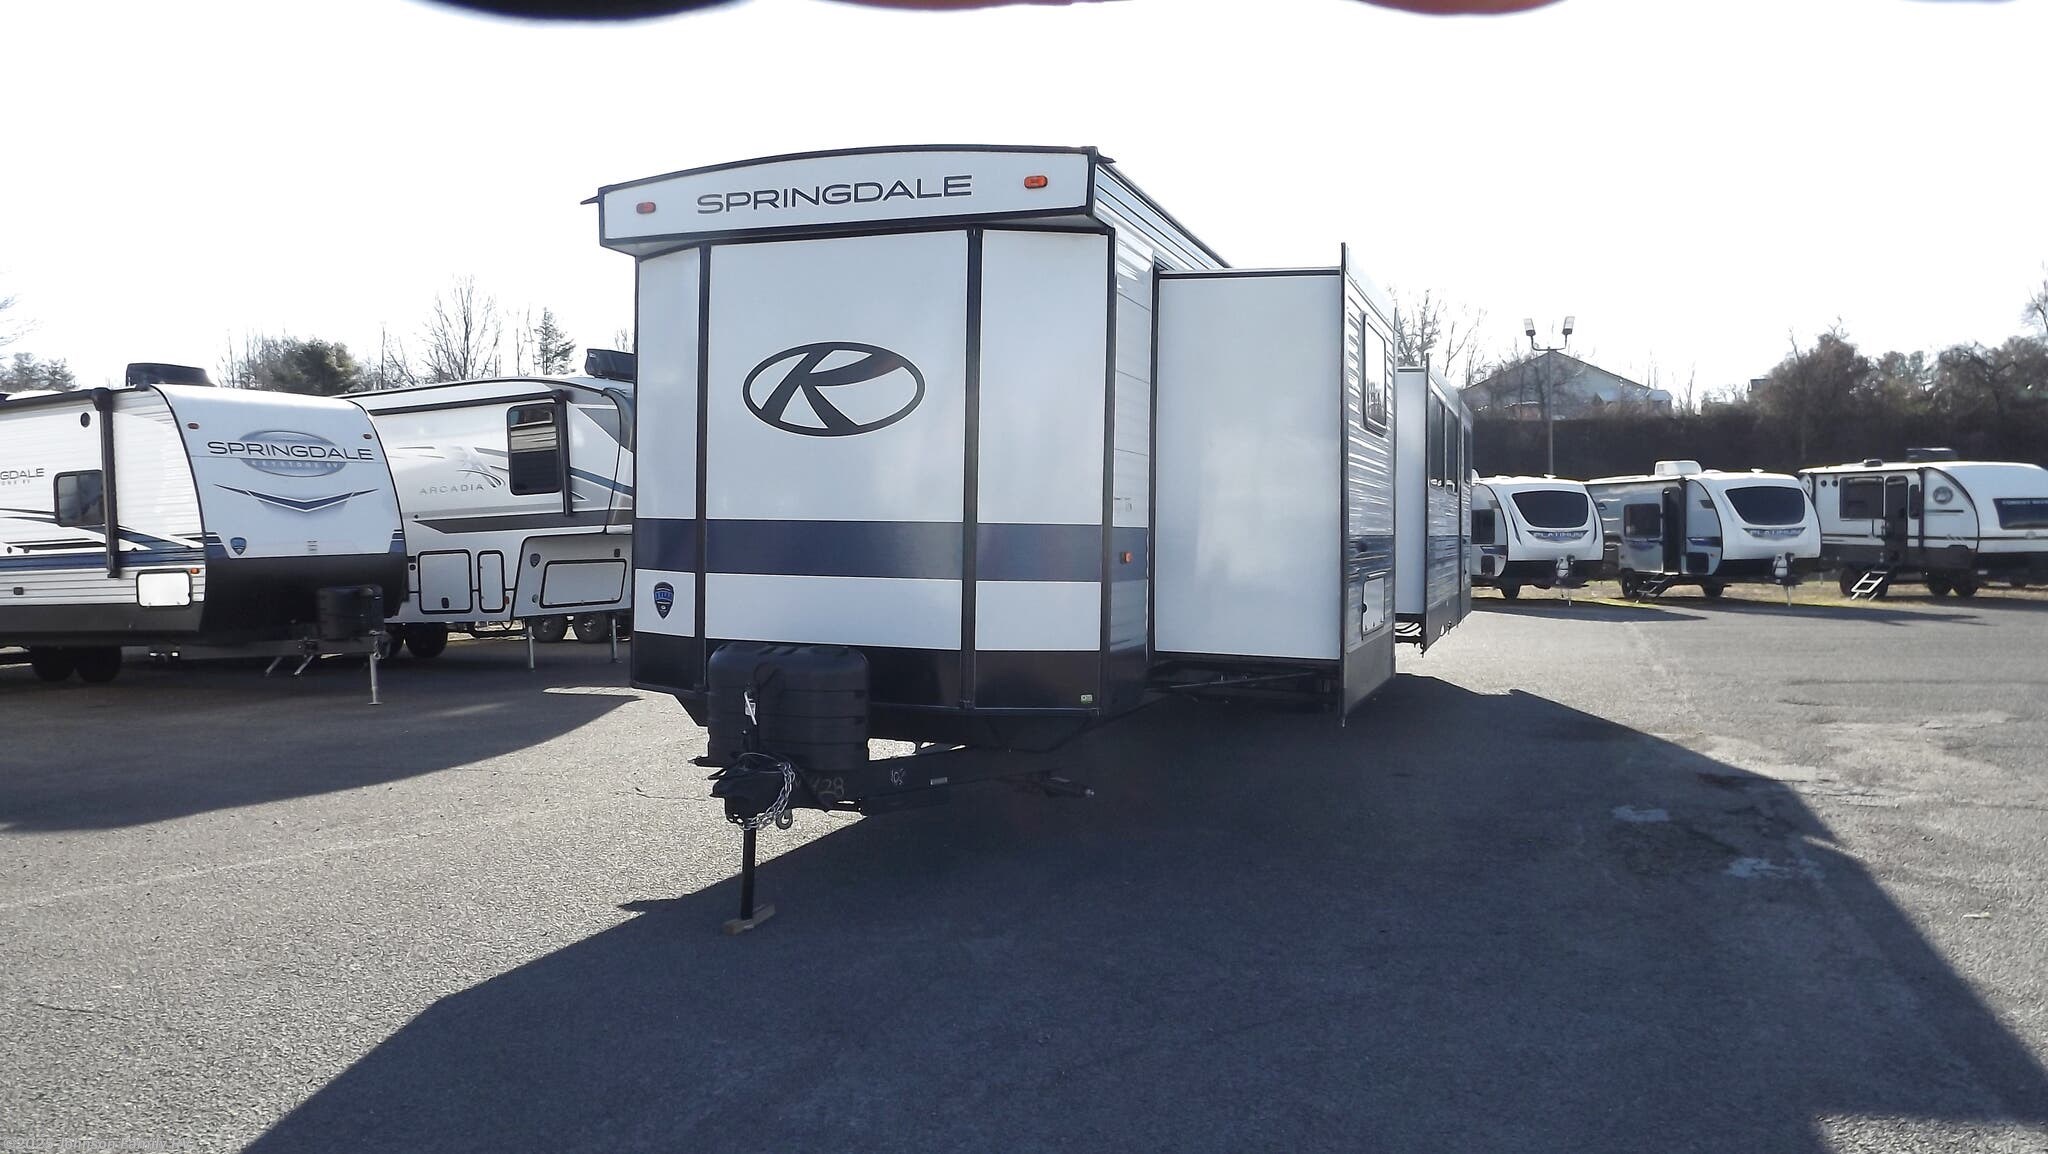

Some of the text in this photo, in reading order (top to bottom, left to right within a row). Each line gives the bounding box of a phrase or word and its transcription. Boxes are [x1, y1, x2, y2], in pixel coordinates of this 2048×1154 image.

[697, 174, 973, 214] SPRINGDALE
[207, 441, 374, 460] SPRINGDALE
[419, 484, 484, 495] ARCADIA
[1533, 530, 1584, 538] PLATINUM
